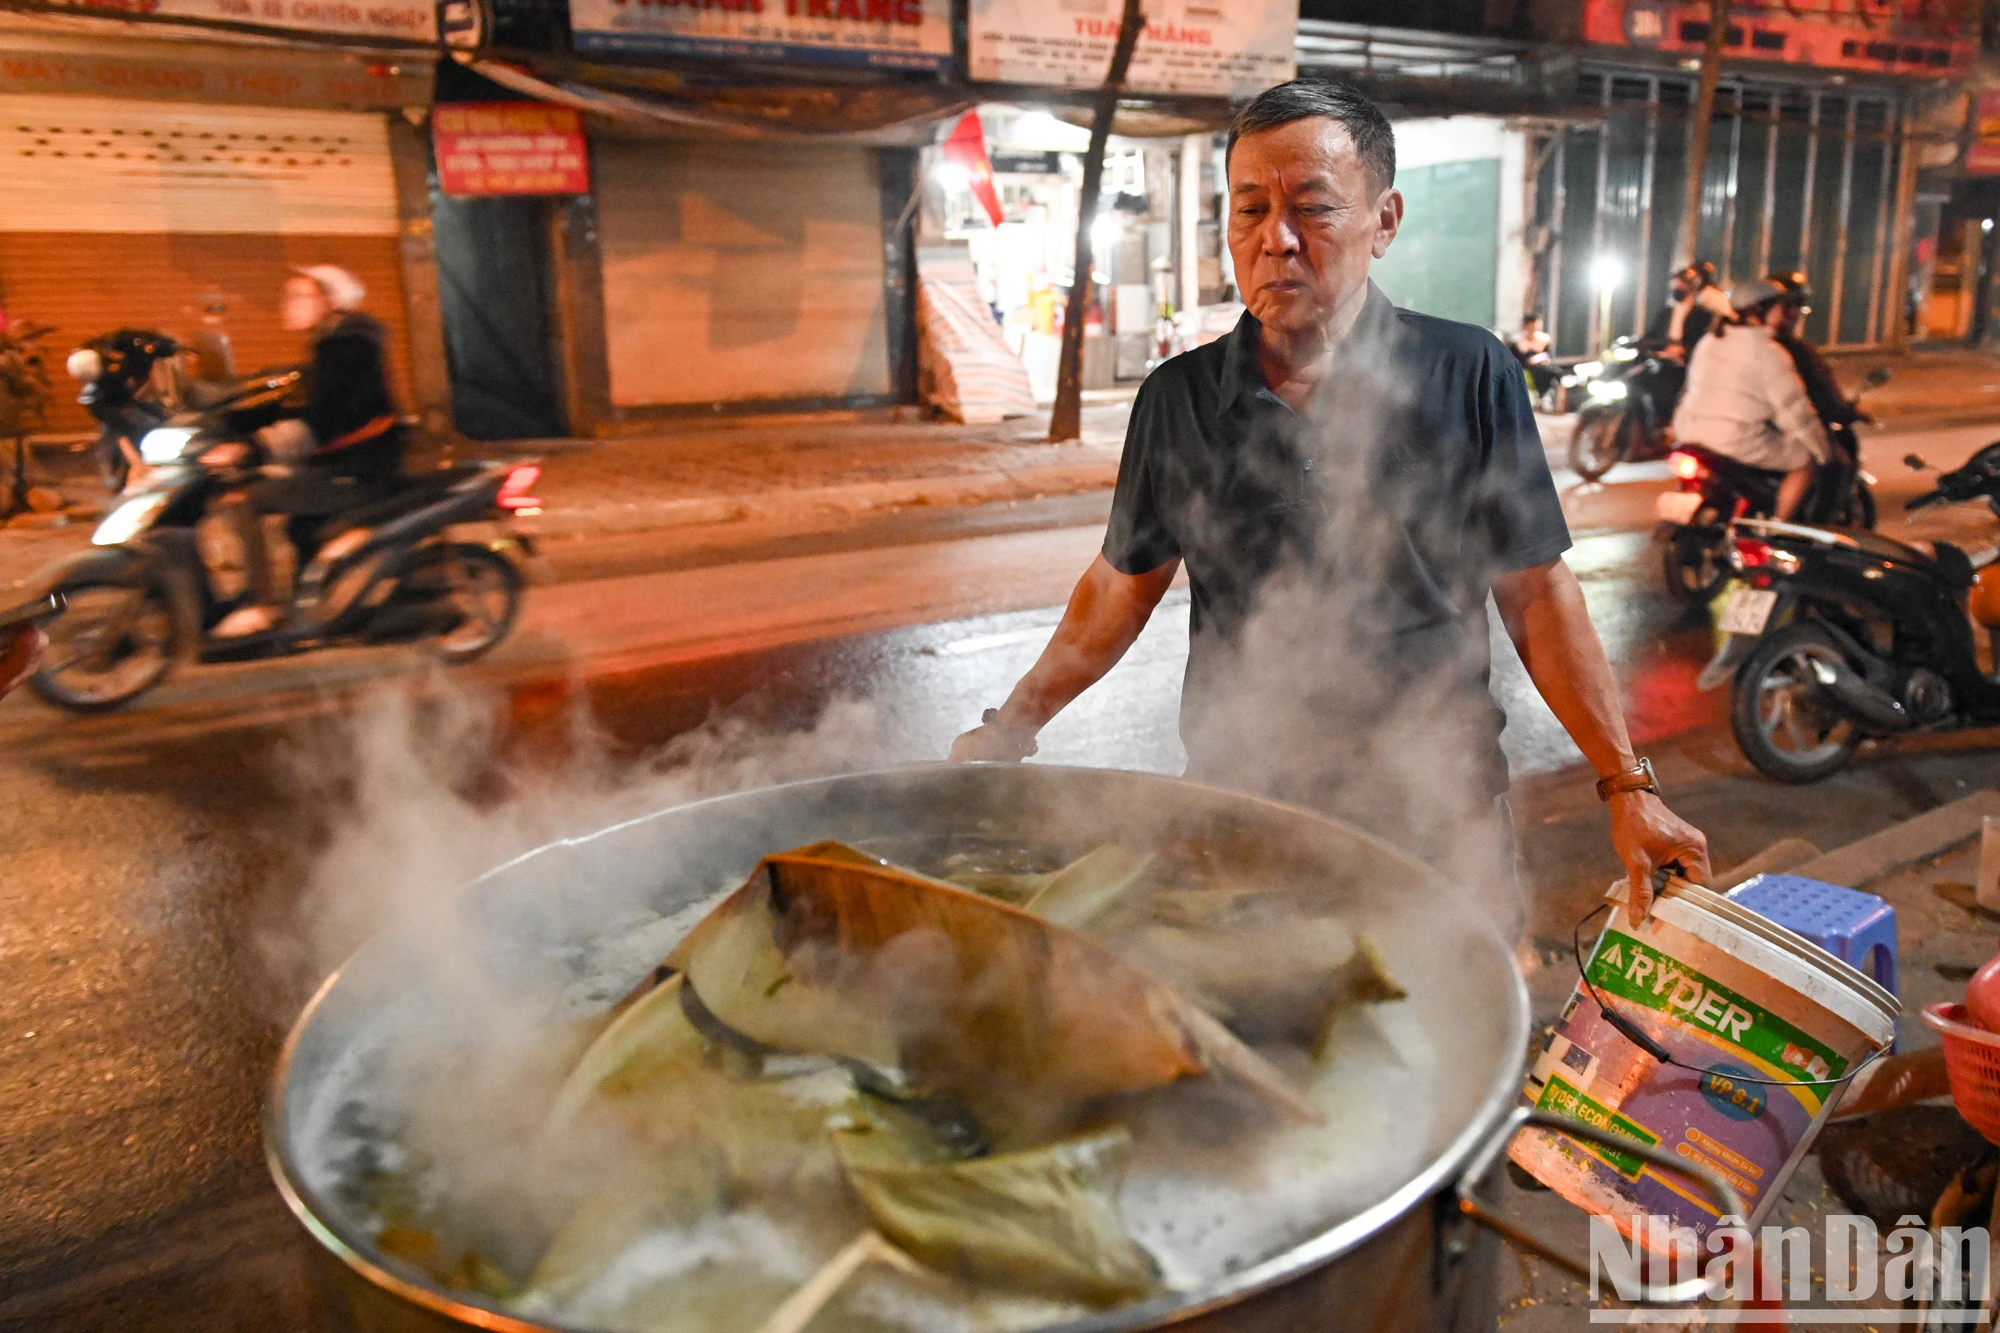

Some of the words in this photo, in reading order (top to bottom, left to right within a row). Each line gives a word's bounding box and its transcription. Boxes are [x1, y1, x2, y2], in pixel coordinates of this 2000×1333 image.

[1624, 952, 1754, 1043] RYDER
[1547, 1083, 1579, 1113] RYDER
[1710, 1075, 1733, 1094] VP
[1732, 1088, 1759, 1113] 8.1
[1694, 1221, 1707, 1234] 18
